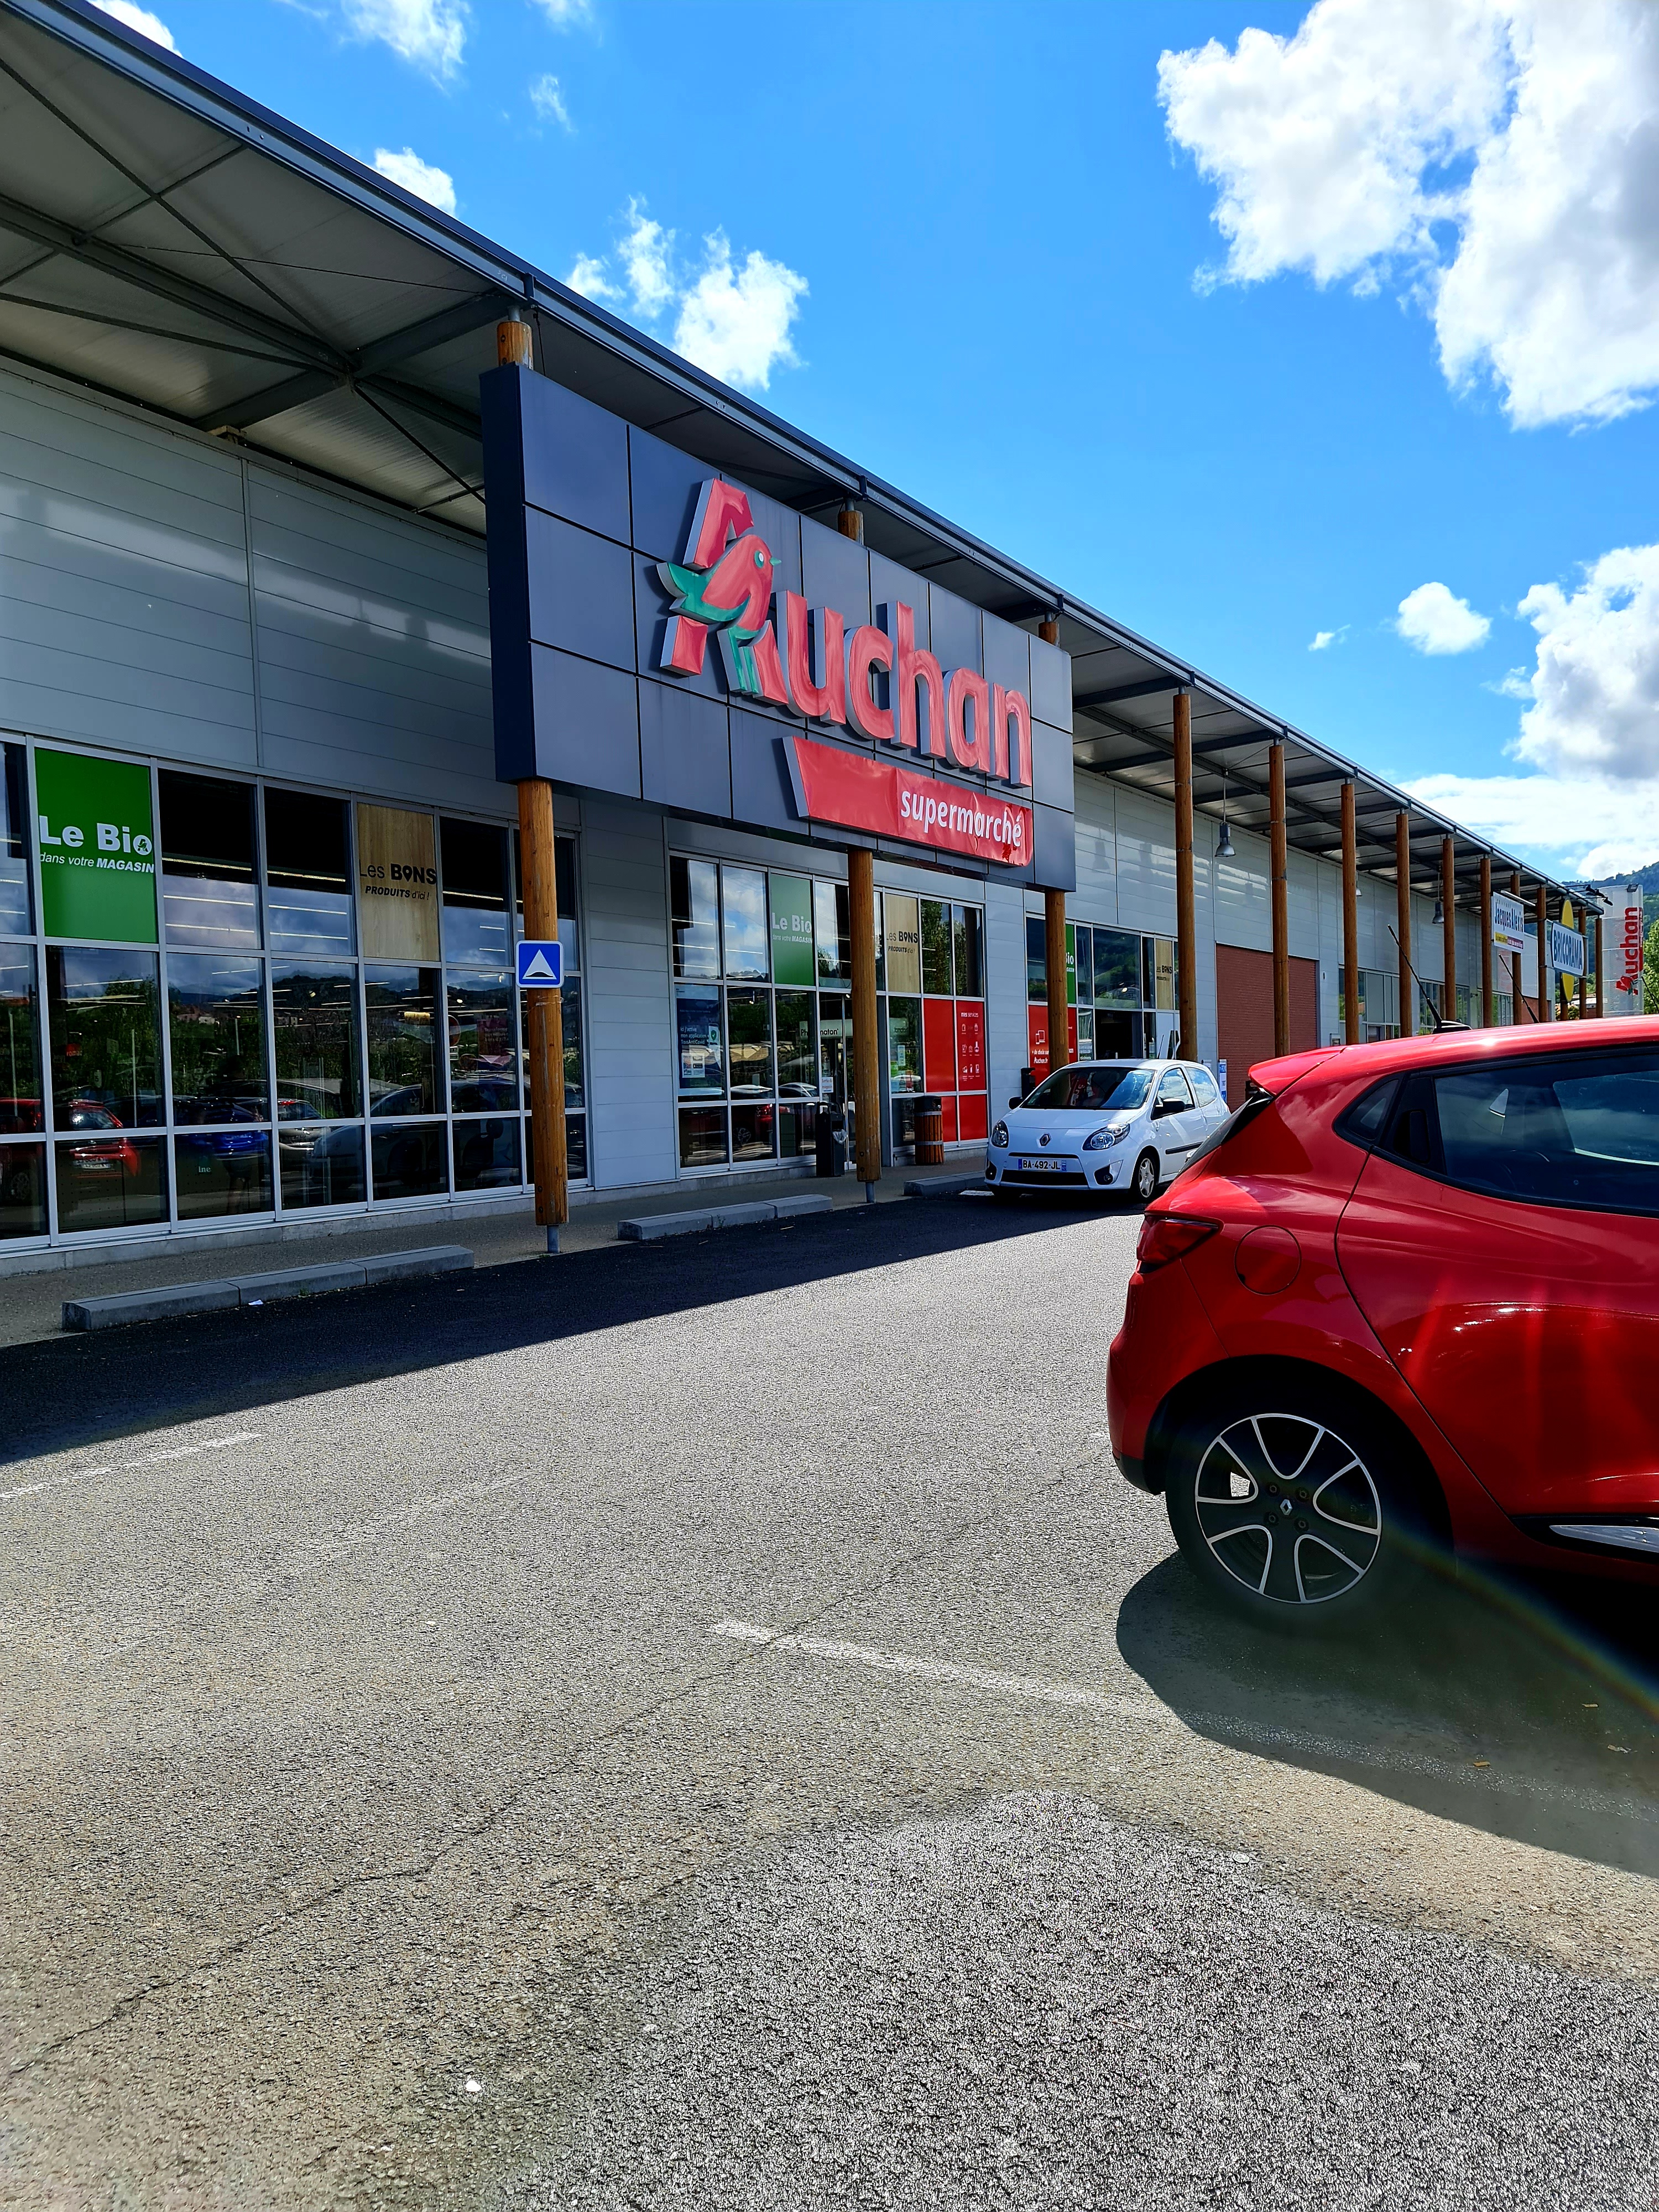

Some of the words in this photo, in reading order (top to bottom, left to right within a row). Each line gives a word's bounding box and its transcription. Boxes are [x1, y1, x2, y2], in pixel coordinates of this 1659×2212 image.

[656, 478, 1032, 788] Auchan
[900, 791, 1022, 847] supermarché
[39, 815, 84, 847] Le
[97, 823, 152, 855] Bio
[40, 852, 65, 864] dans
[69, 857, 95, 867] votre
[96, 858, 154, 873] MAGASIN
[359, 859, 385, 879] Les
[390, 863, 437, 885] BONS
[365, 885, 410, 898] PRODUITS
[412, 890, 426, 900] d'ici
[772, 912, 787, 930] Le
[792, 915, 812, 933] Bio
[792, 936, 812, 944] MAGASIN
[886, 932, 896, 941] es
[899, 931, 918, 943] BONS
[1553, 930, 1583, 970] BRICORAMA
[1616, 907, 1638, 995] Auchan
[1022, 1160, 1061, 1170] BA-492-JL
